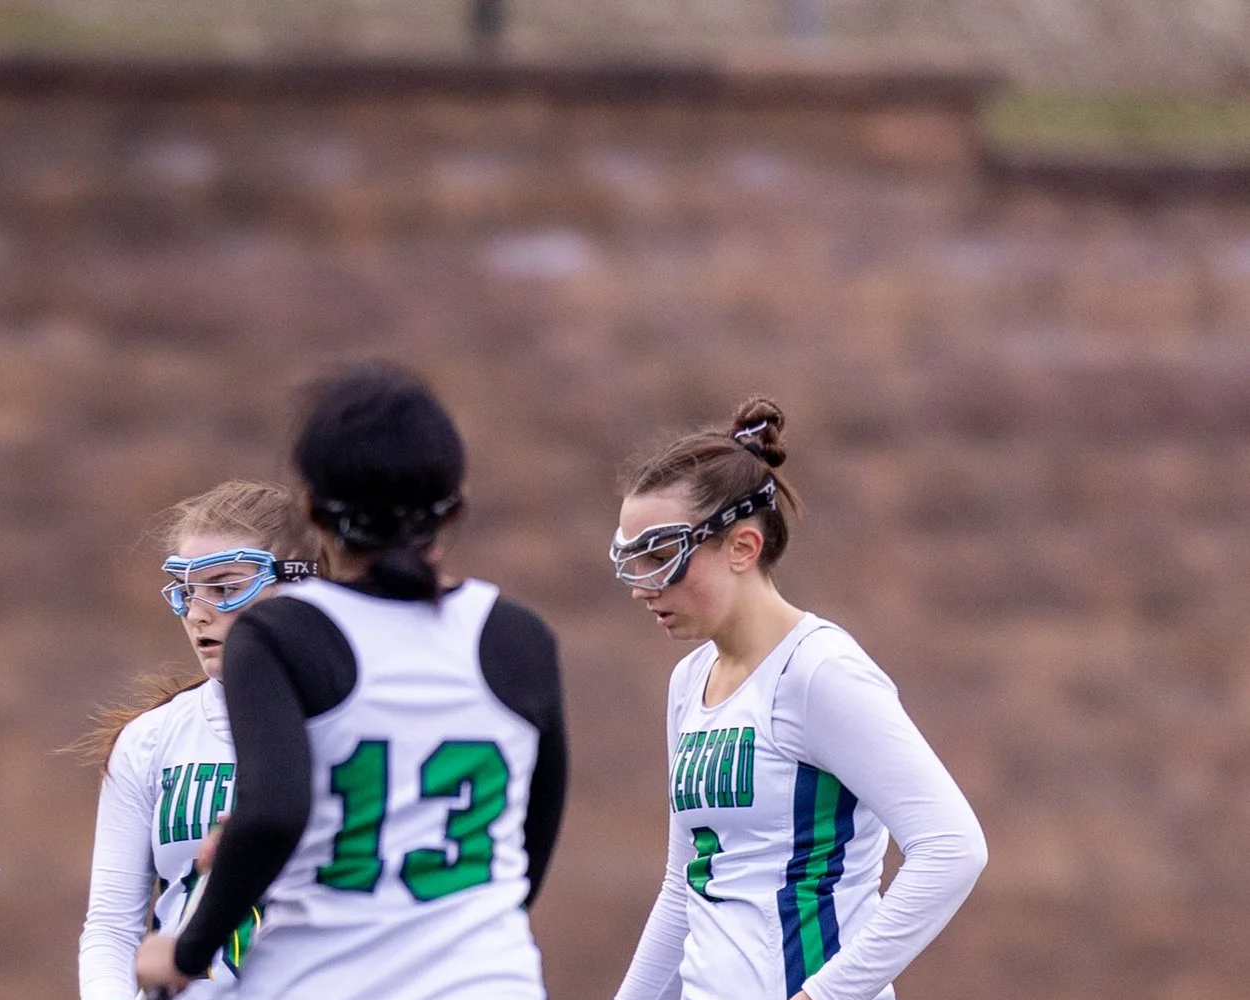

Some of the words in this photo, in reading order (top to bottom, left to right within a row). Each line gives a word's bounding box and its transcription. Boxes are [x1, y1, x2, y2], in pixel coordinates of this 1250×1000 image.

[283, 561, 310, 574] STX
[159, 763, 239, 845] WATE
[670, 726, 755, 813] ERFORD
[316, 740, 510, 904] 13
